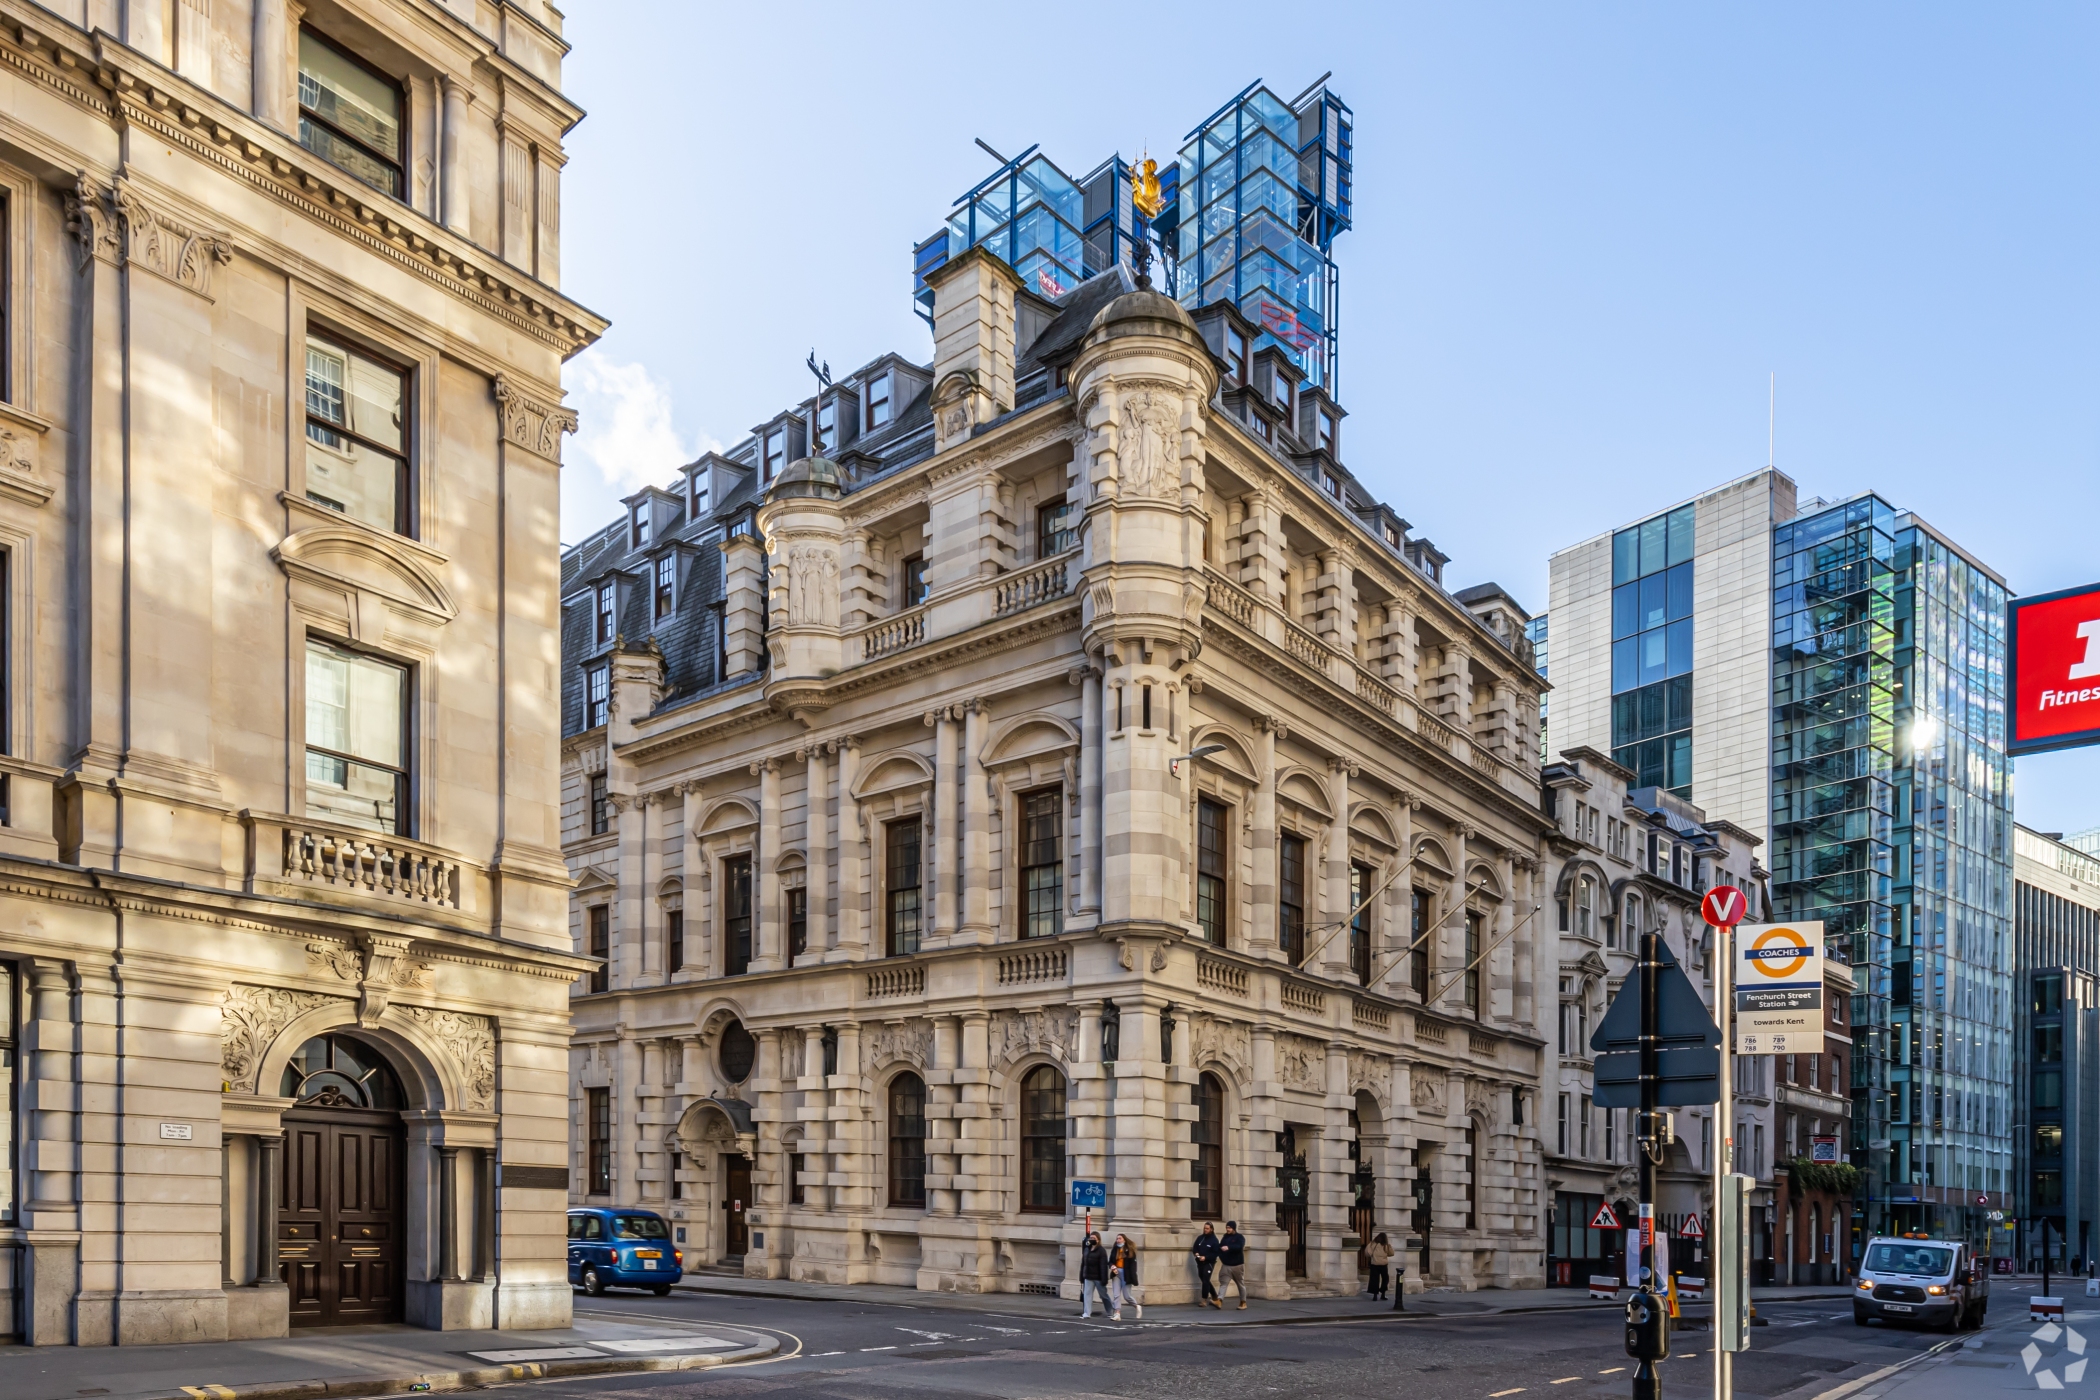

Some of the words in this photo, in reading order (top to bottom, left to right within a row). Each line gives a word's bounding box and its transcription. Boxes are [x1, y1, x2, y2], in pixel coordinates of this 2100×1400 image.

[1709, 891, 1738, 922] V
[1758, 948, 1800, 958] COACHES
[1746, 993, 1786, 1001] Fenchurch
